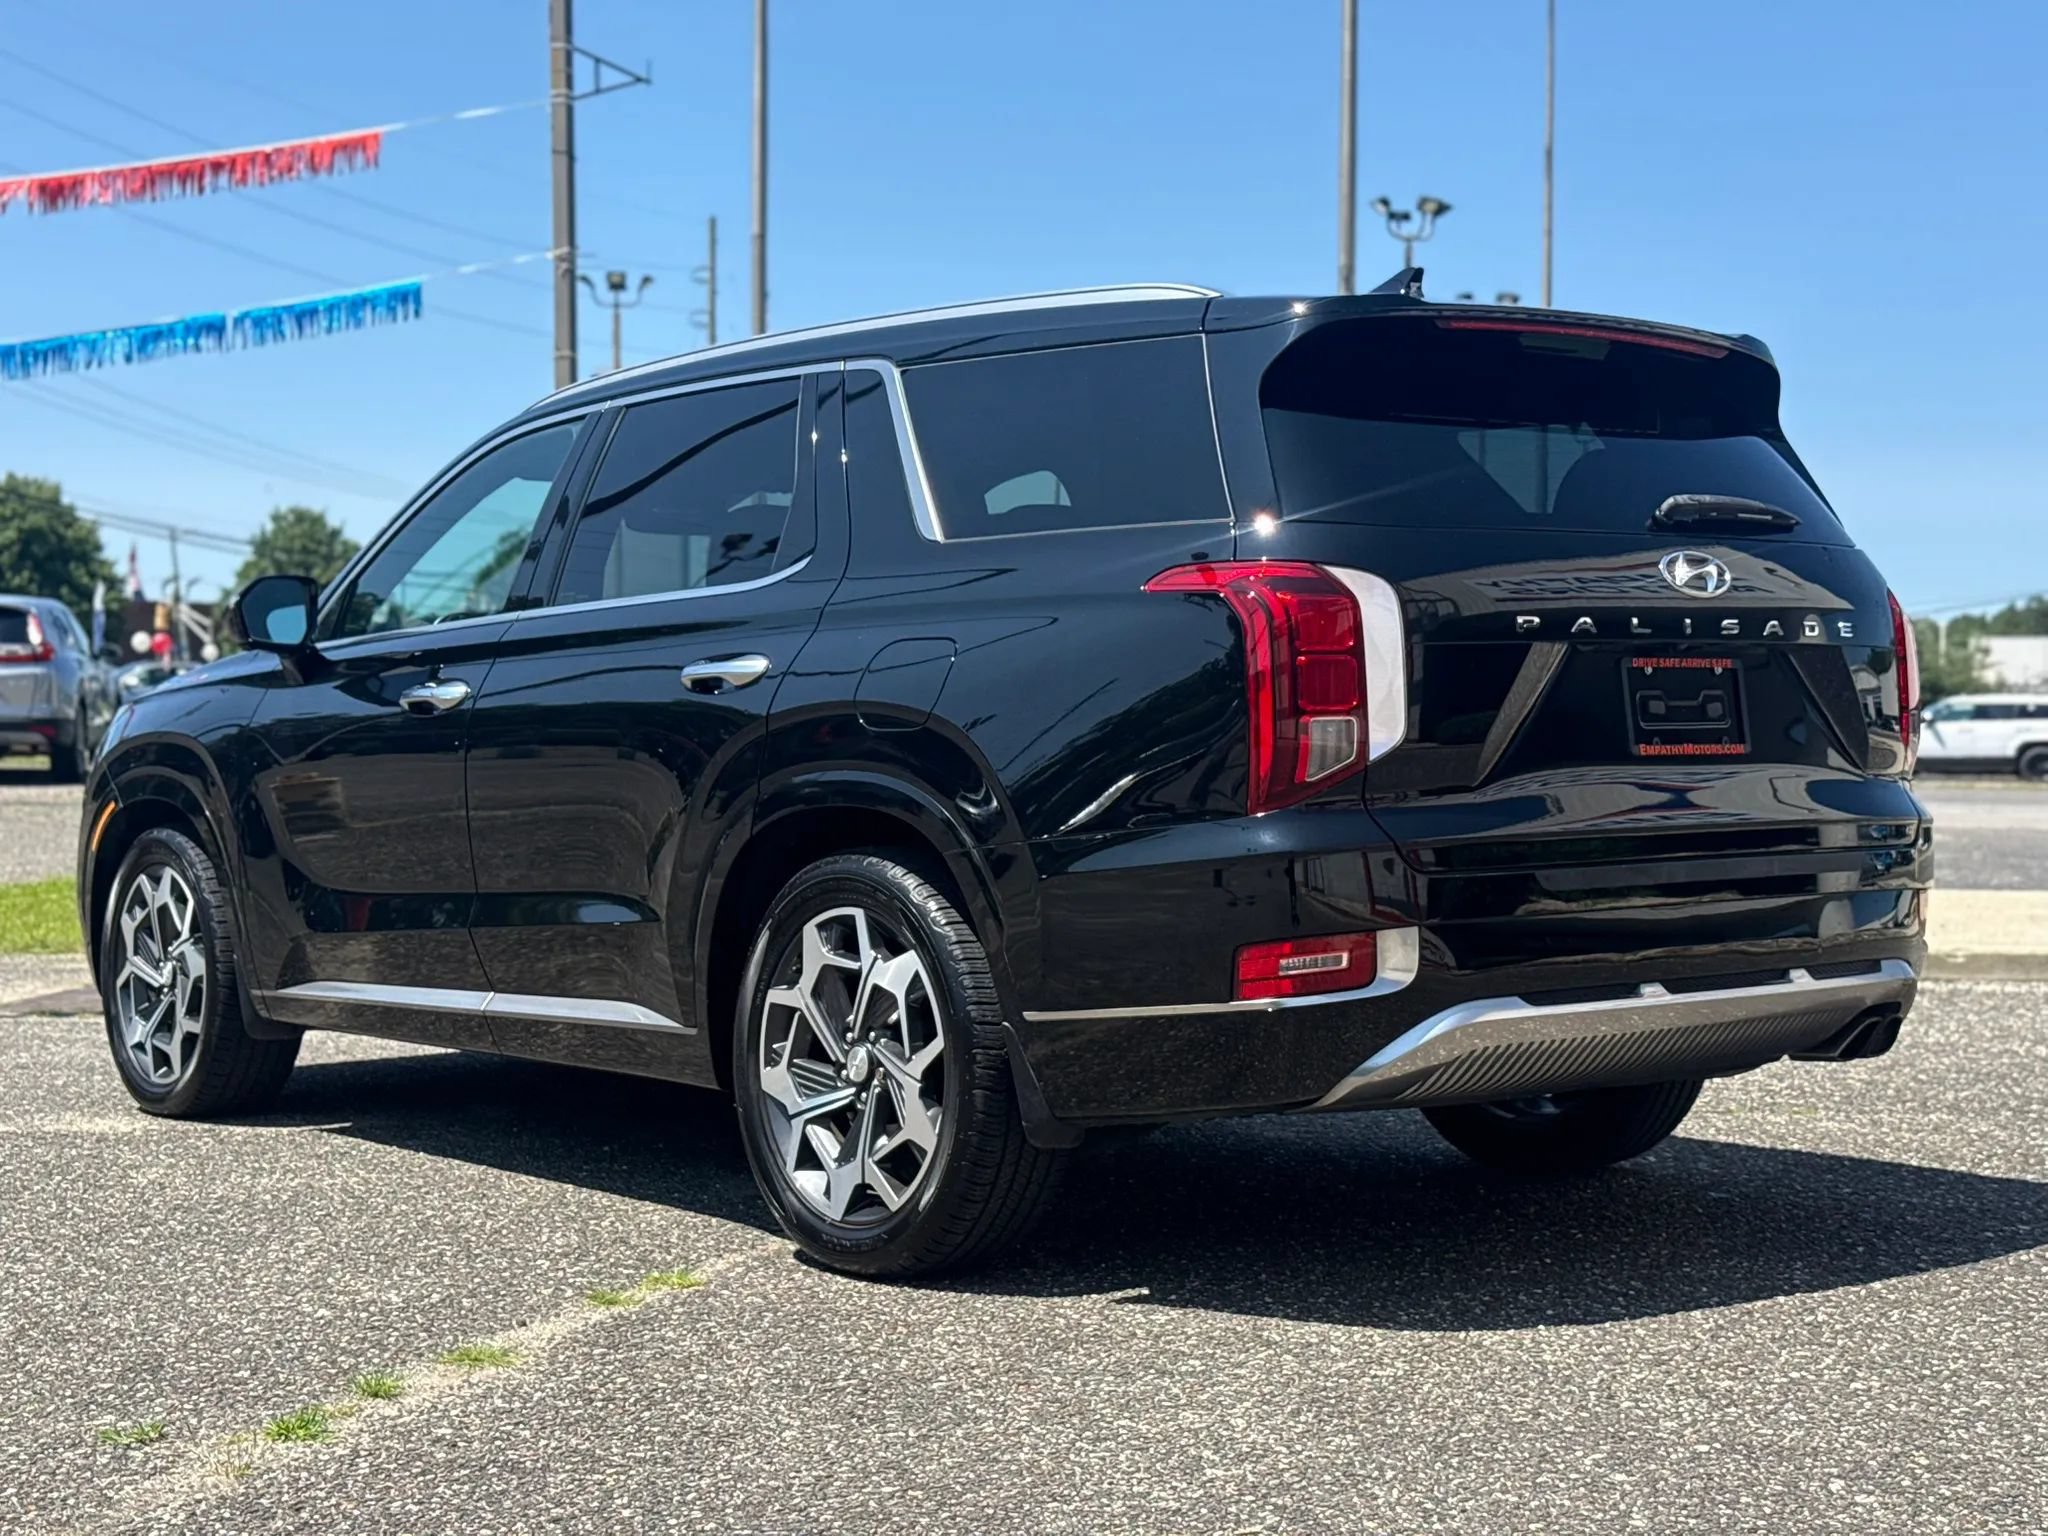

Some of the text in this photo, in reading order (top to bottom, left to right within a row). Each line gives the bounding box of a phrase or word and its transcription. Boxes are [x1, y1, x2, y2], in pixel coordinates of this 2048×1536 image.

[1515, 614, 1855, 638] PALISADE
[1632, 658, 1732, 668] DRIVE SAFE ARRIVE SAFE
